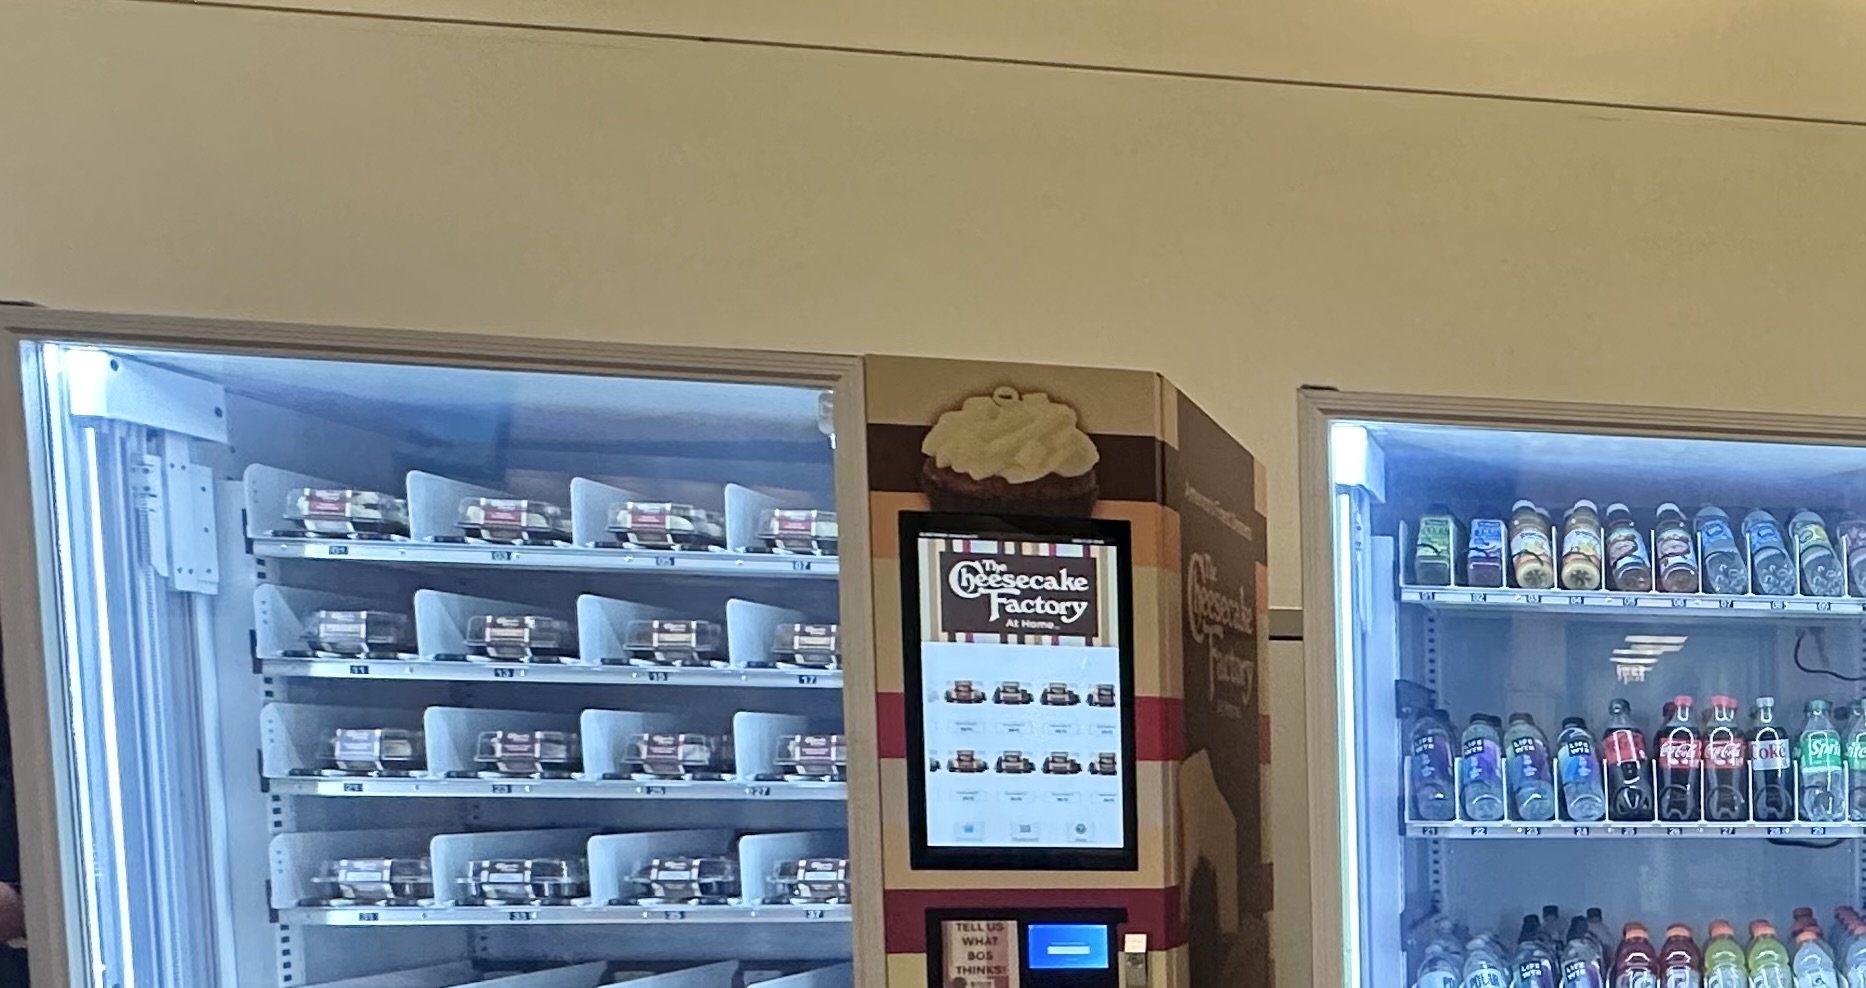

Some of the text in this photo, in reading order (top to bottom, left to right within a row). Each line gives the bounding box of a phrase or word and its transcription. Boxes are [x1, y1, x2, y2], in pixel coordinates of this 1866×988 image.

[982, 560, 1007, 572] The
[949, 560, 1089, 598] Cheesecake
[979, 587, 1088, 623] Factory
[956, 923, 1004, 931] TELL US
[962, 937, 997, 945] WHAT
[968, 952, 993, 960] BOS
